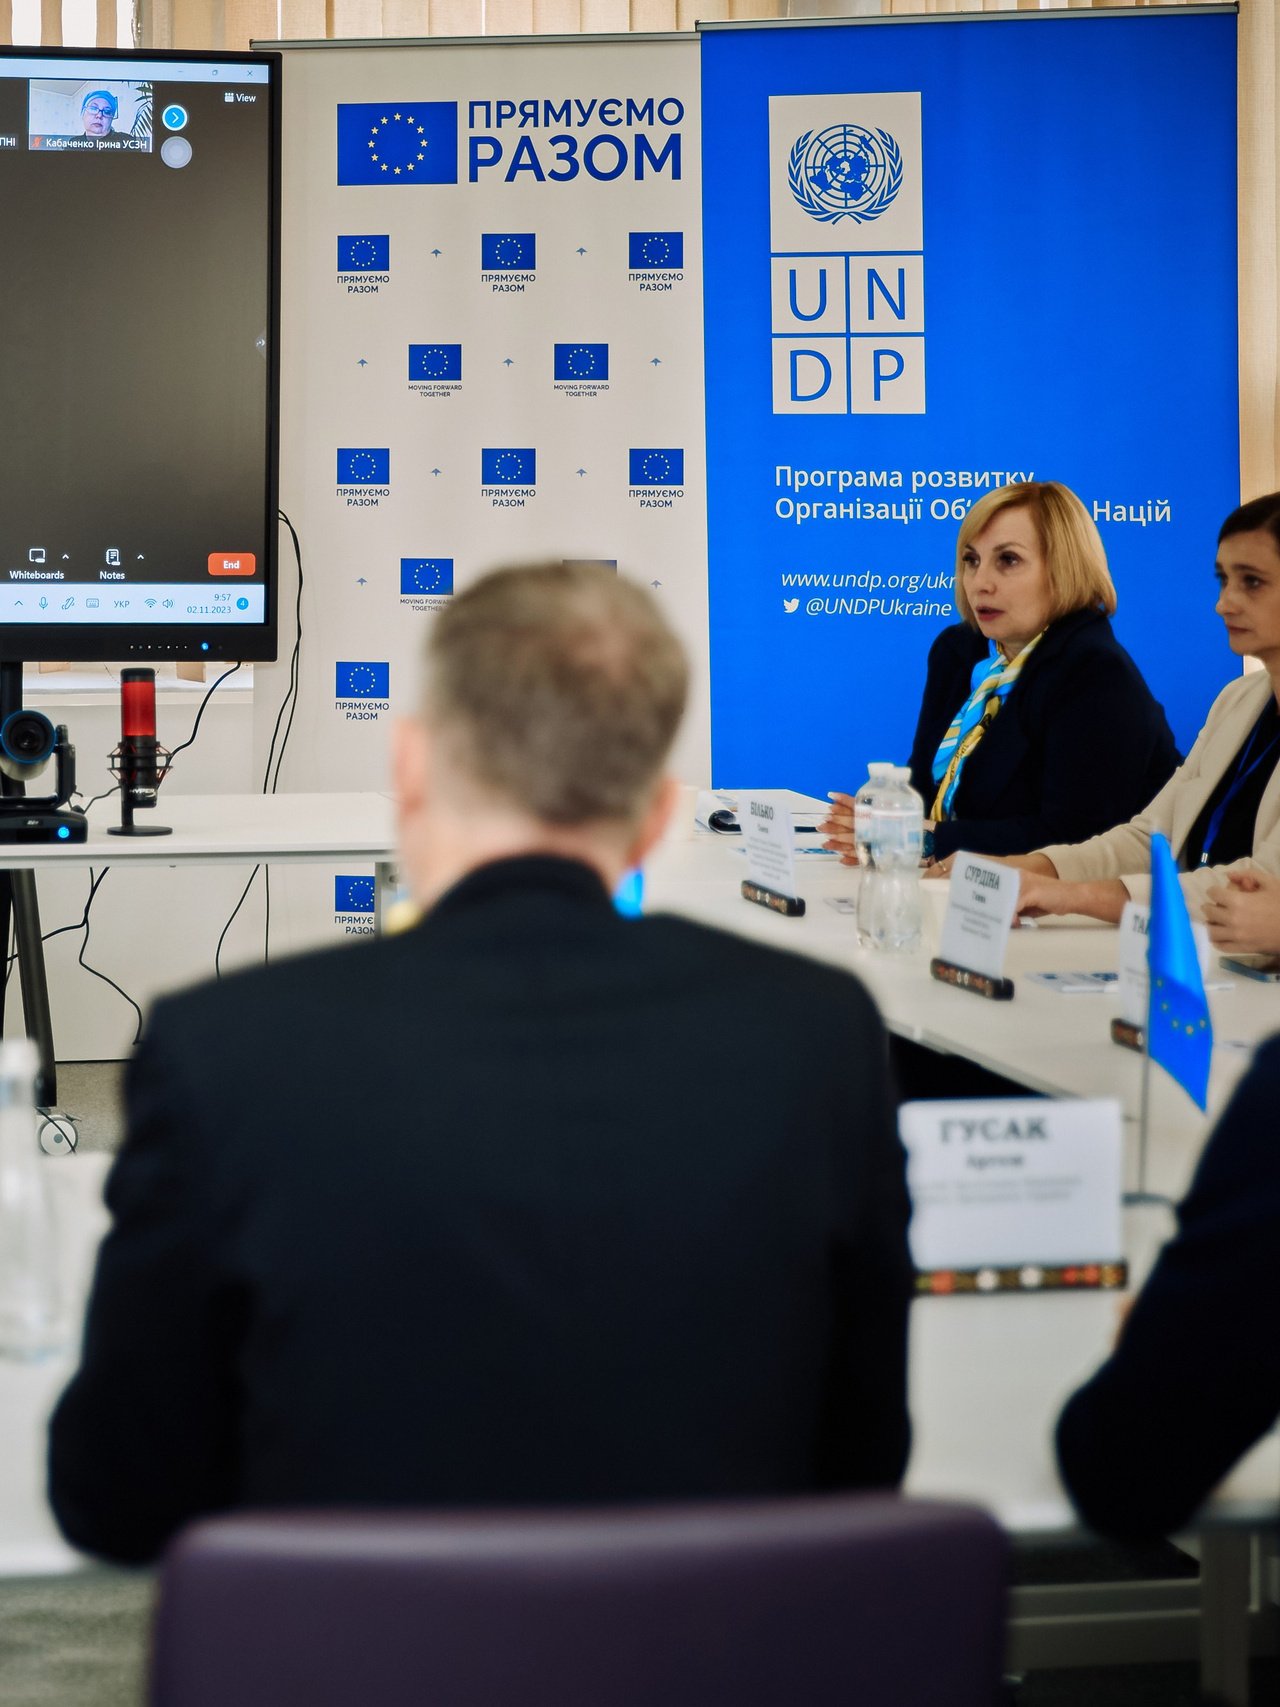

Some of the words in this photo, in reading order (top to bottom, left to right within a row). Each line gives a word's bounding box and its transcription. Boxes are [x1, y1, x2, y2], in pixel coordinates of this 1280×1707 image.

[236, 93, 256, 103] View
[469, 98, 685, 129] ПРЯМУЄМО
[0, 138, 16, 147] ПНІ
[46, 139, 94, 149] Кабаченко
[96, 140, 120, 150] Ірина
[122, 140, 147, 149] УСЗН
[469, 133, 682, 183] РАЗОМ
[337, 275, 390, 284] ПРЯМУЄМО
[481, 273, 536, 283] ПРЯМУЄМО
[628, 272, 684, 282] ПРЯМУЄМО
[347, 285, 379, 294] РАЗОМ
[492, 284, 525, 293] РАЗОМ
[639, 282, 672, 291] РАЗОМ
[775, 465, 903, 493] Програма
[336, 488, 390, 498] ПРЯМУЄМО
[481, 488, 536, 498] ПРЯМУЄМО
[628, 489, 684, 498] ПРЯМУЄМО
[347, 498, 379, 507] РАЗОМ
[492, 499, 525, 508] РАЗОМ
[639, 500, 672, 508] РАЗОМ
[775, 498, 923, 525] Організації
[1093, 499, 1171, 527] Націй
[223, 561, 240, 570] End
[10, 571, 65, 580] Whiteboards
[100, 571, 125, 580] Notes
[781, 570, 956, 594] www.undp.org/ukr
[214, 593, 231, 602] 9:57
[113, 600, 130, 609] УКР
[806, 598, 952, 617] @UNDPUkraine
[187, 606, 232, 615] 02.11.2023
[335, 701, 390, 711] ПРЯМУЄМО
[346, 712, 379, 720] РАЗОМ
[335, 916, 374, 924] ПРЯМУЄ
[940, 1117, 1048, 1144] ГУСАК
